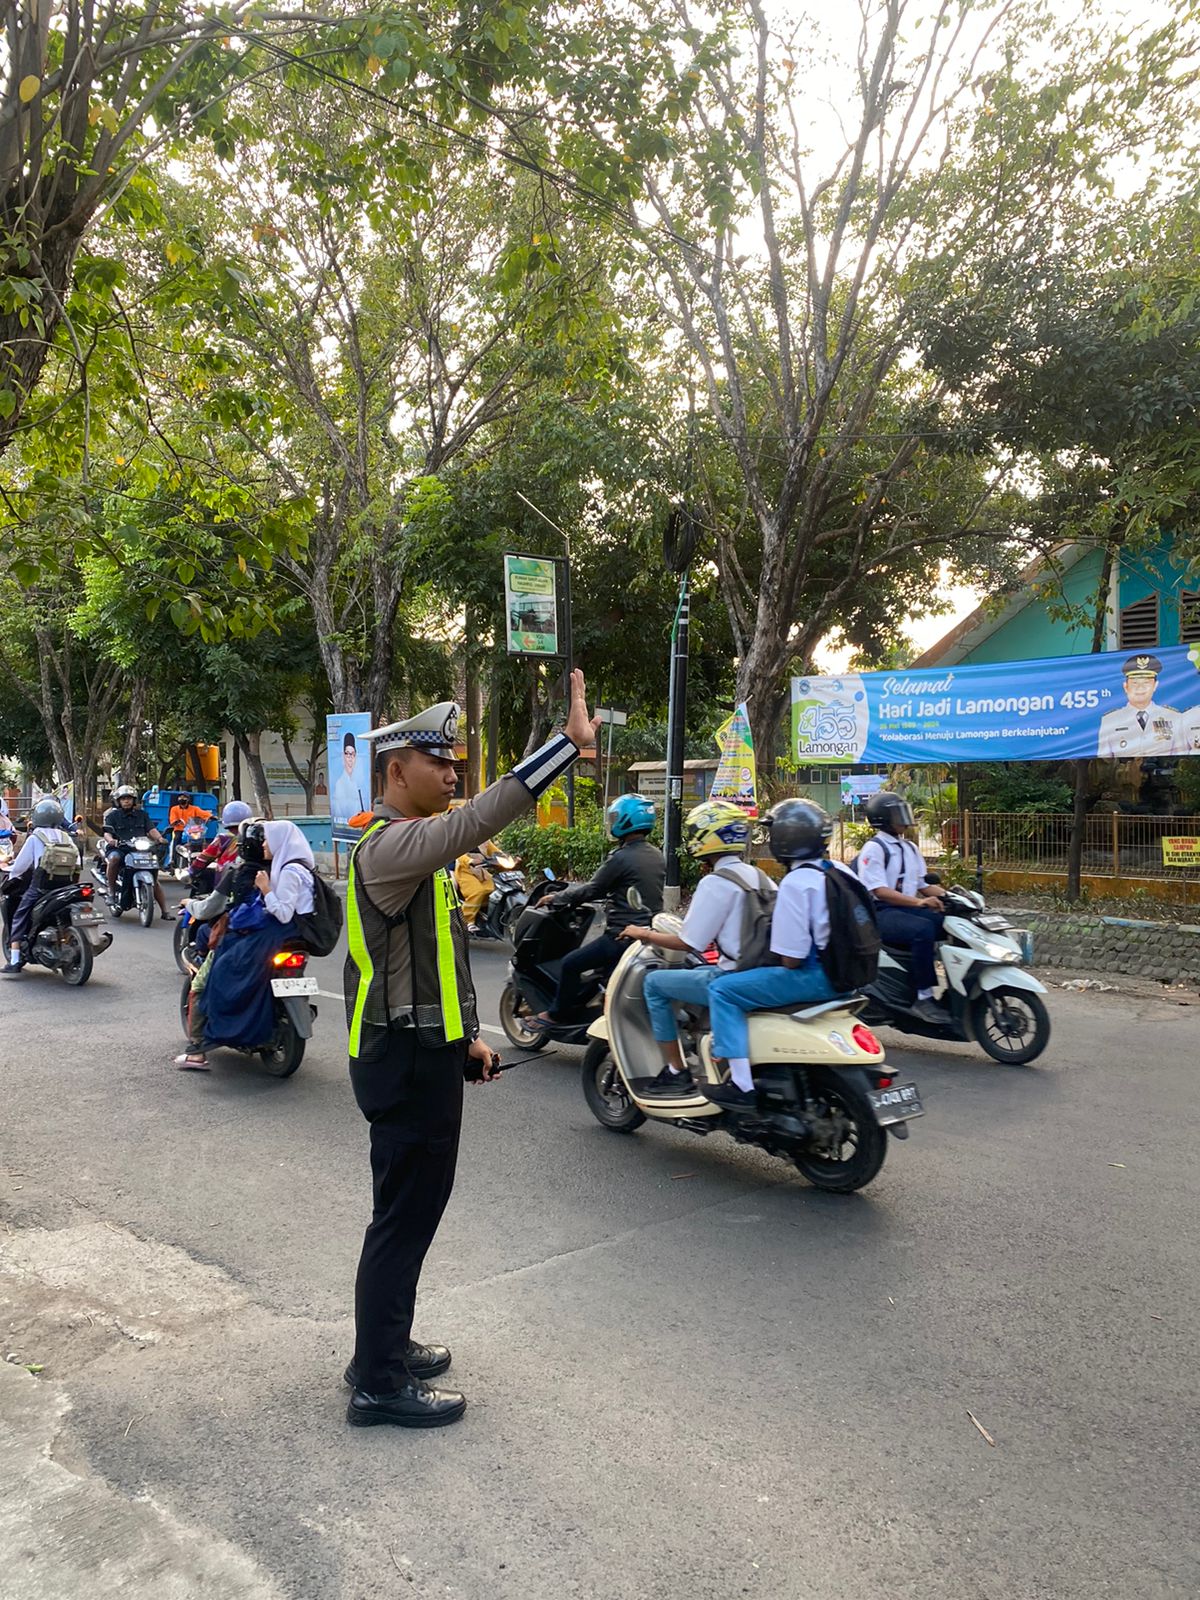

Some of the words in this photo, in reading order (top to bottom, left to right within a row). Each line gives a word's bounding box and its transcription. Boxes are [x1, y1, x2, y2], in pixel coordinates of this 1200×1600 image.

[880, 672, 954, 699] Selamat
[879, 700, 912, 719] Hari
[916, 697, 951, 717] Jadi
[956, 695, 1054, 716] Lamongan
[925, 730, 954, 740] Menuju
[956, 730, 1000, 740] Lamongan
[799, 741, 858, 755] Lamongan
